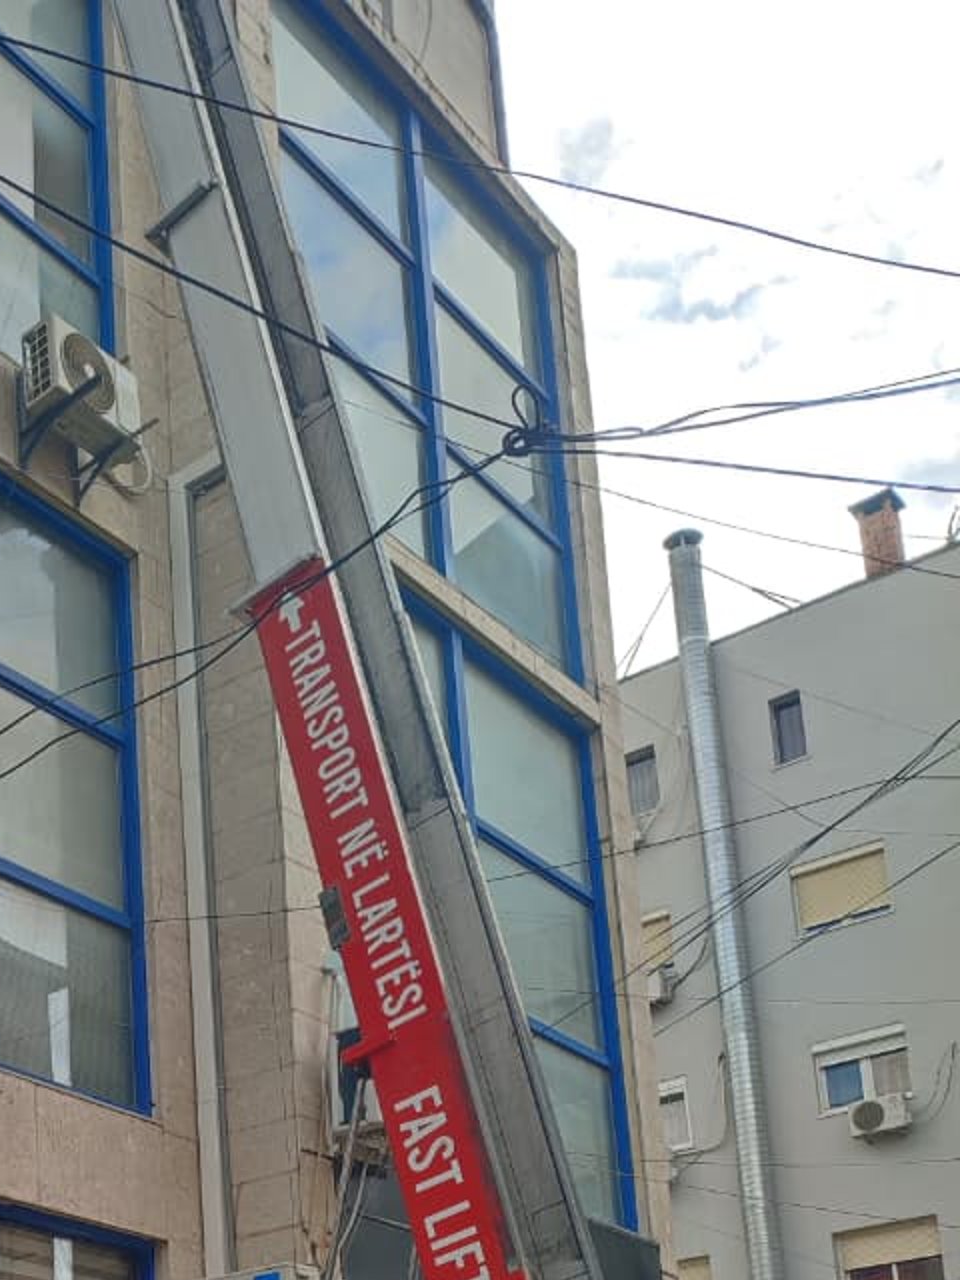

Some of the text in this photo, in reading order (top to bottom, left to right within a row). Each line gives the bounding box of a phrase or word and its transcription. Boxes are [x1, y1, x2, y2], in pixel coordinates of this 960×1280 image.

[283, 624, 428, 1031] TRANSPORT NË LARTËSI
[393, 1083, 472, 1195] FAST
